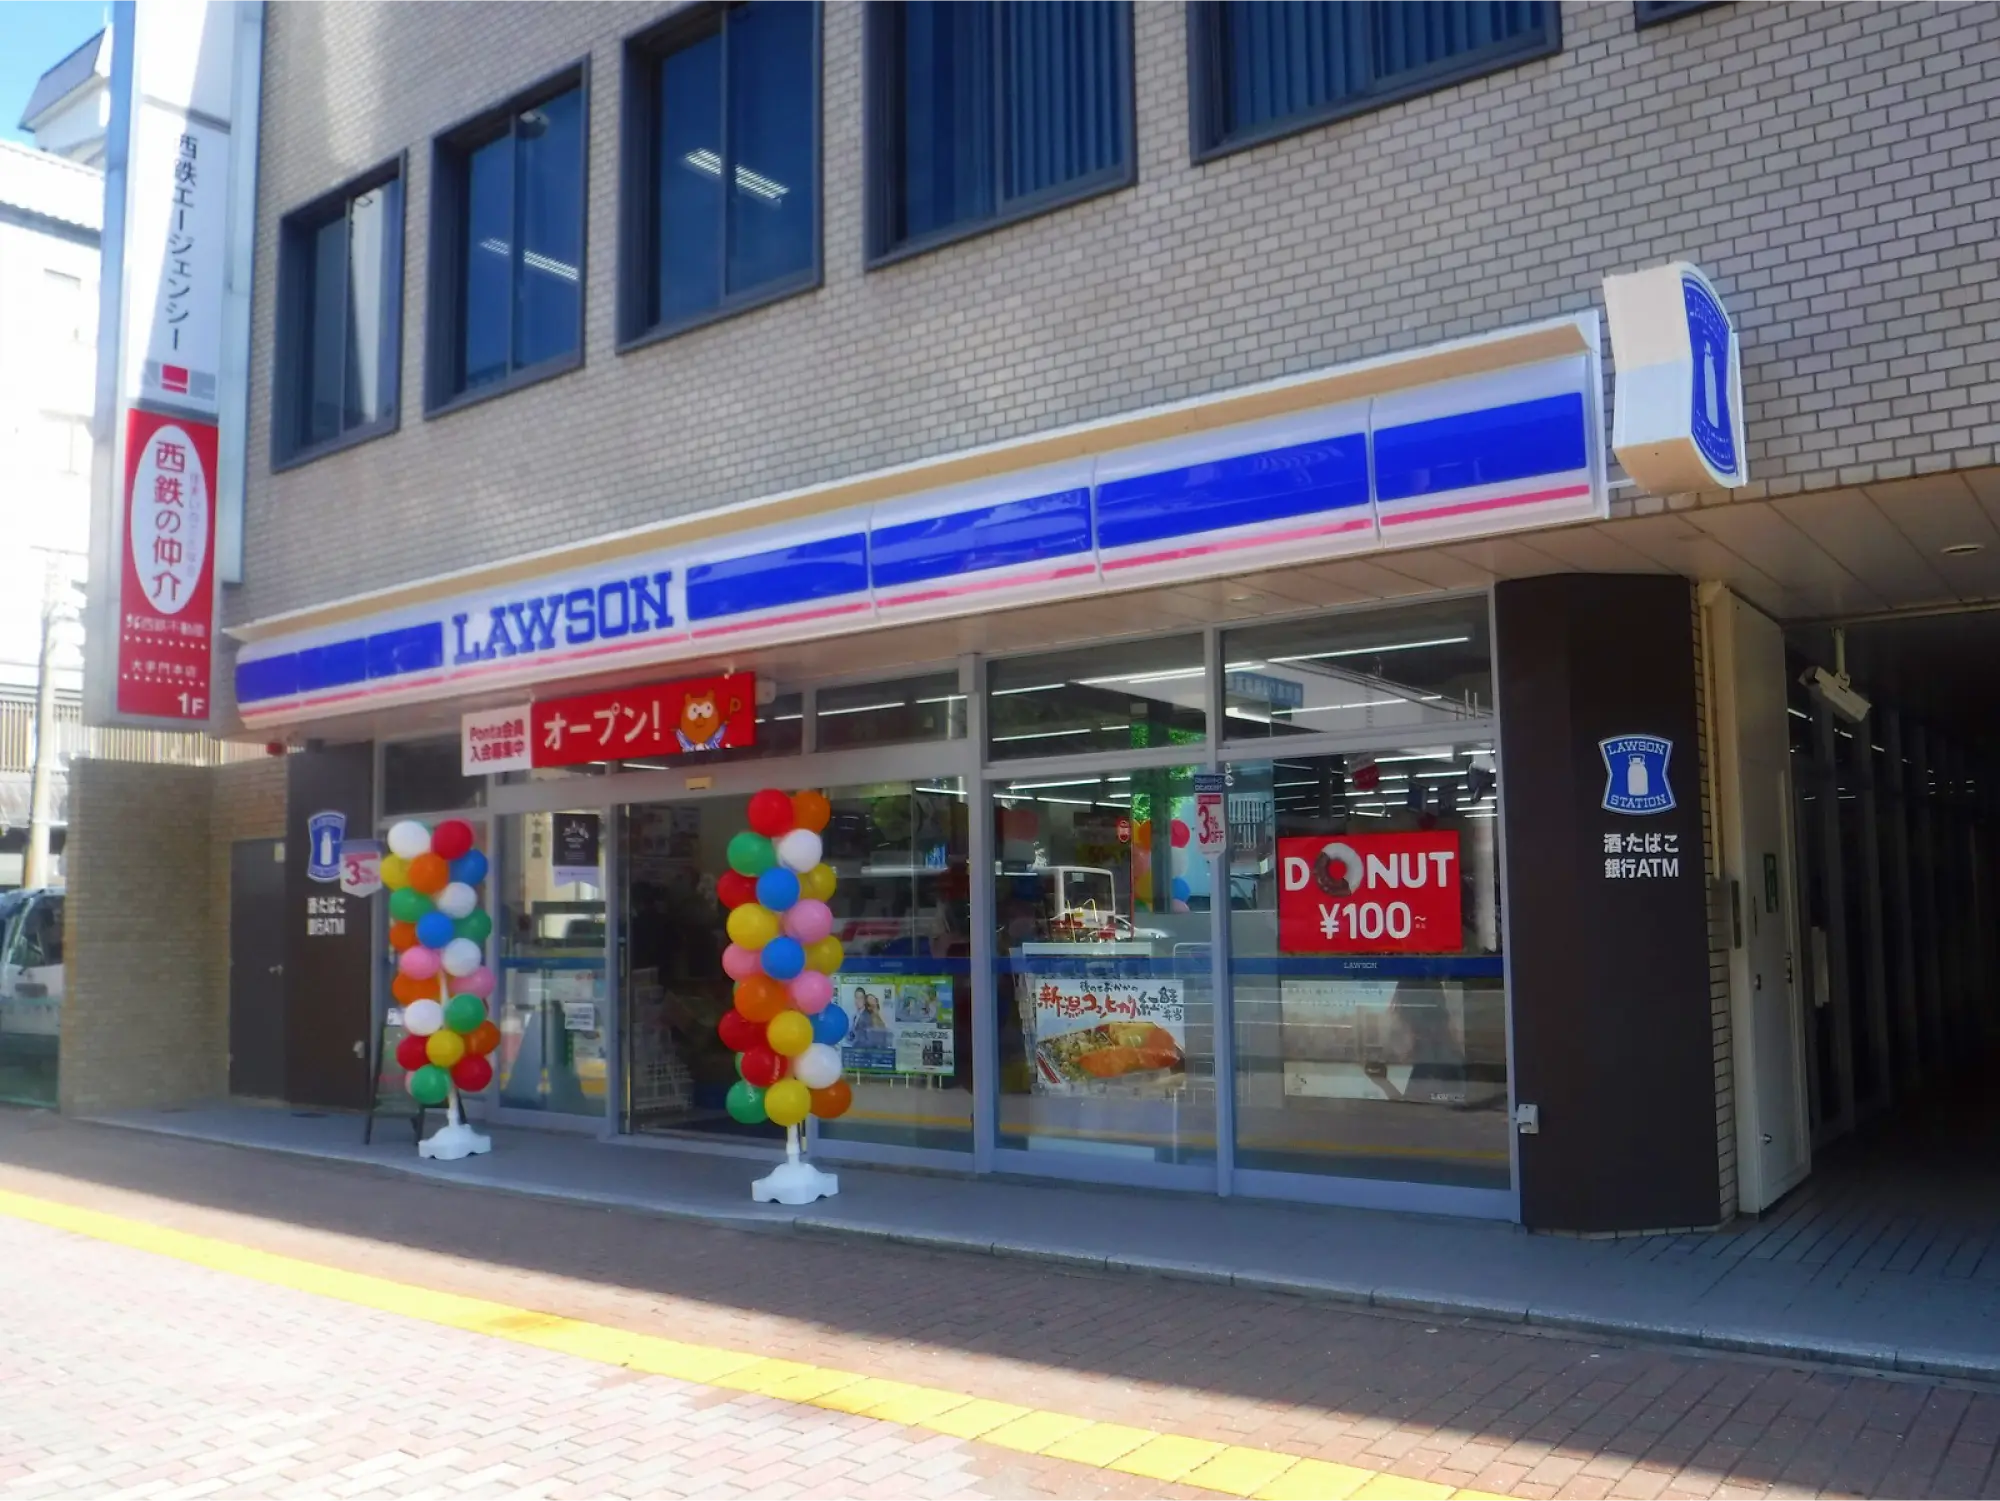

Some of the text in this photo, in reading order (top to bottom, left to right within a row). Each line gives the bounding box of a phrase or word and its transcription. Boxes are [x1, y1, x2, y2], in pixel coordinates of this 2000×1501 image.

[165, 133, 198, 351] 西鉄エージェンシー
[152, 440, 187, 603] 西鉄の仲介
[451, 569, 676, 666] LAWSON
[178, 691, 206, 716] 1F
[1606, 740, 1665, 756] LAWSON
[1609, 793, 1667, 809] STATION
[1604, 857, 1680, 879] 銀行ATM
